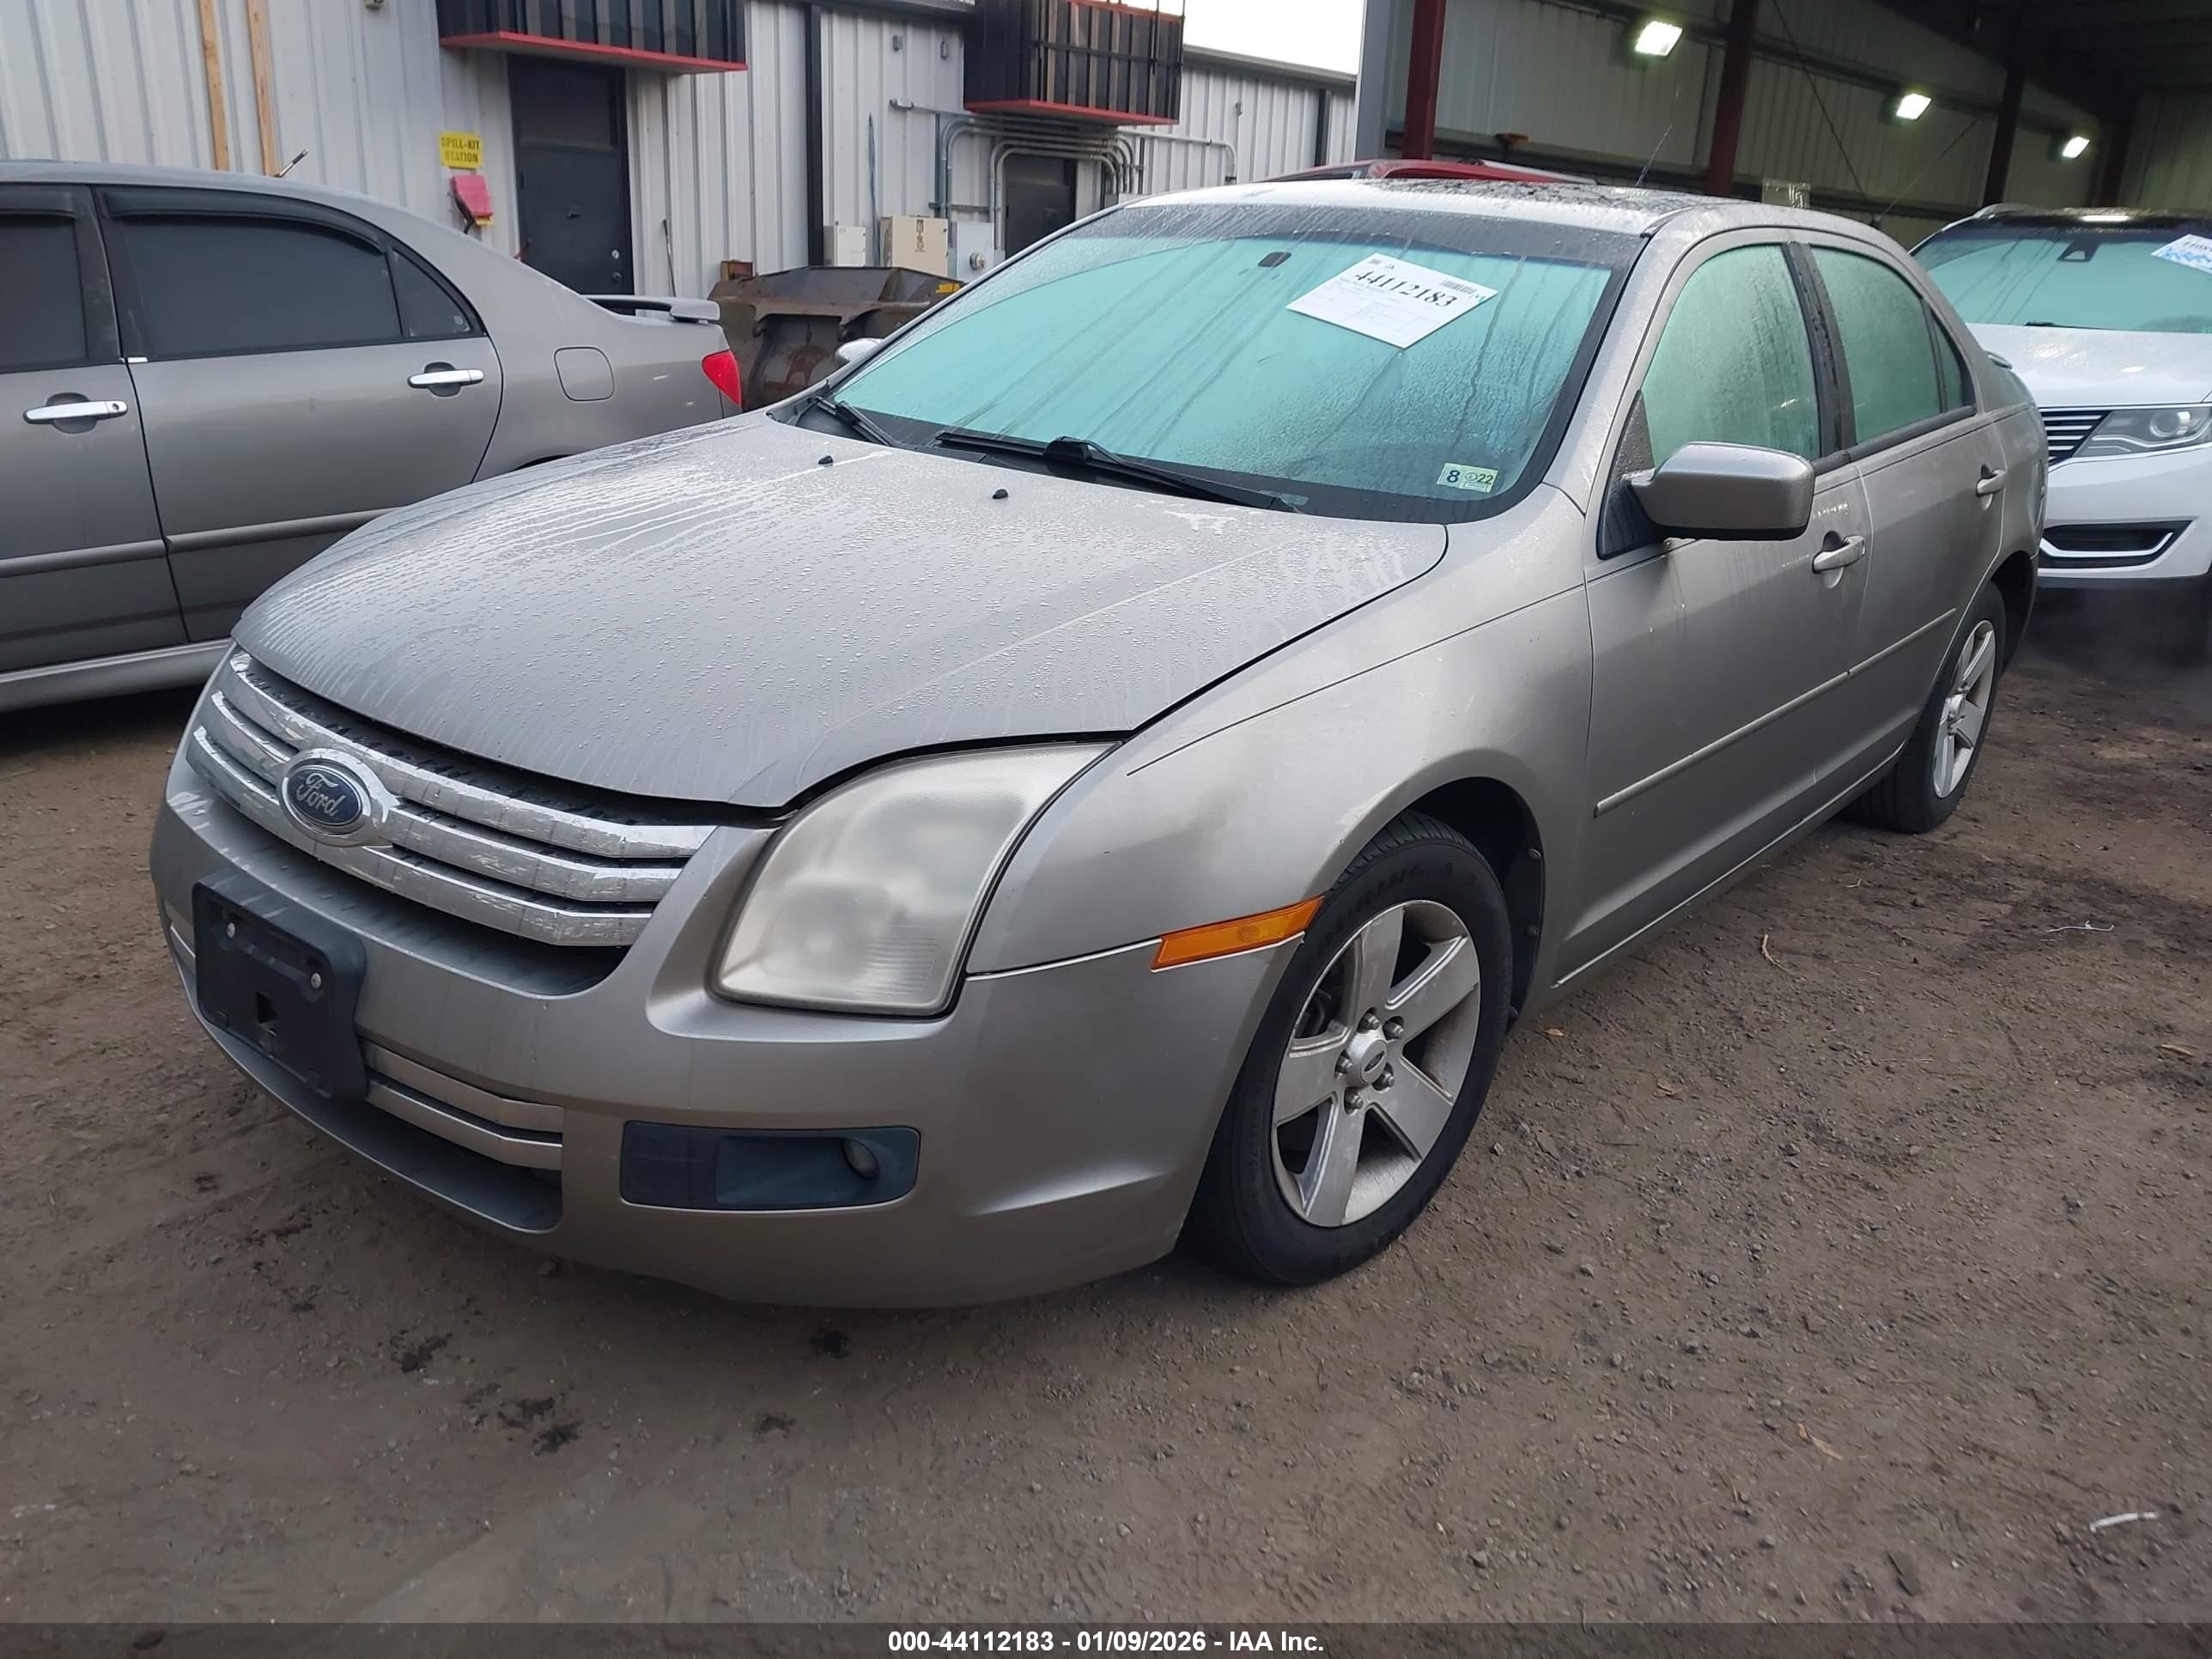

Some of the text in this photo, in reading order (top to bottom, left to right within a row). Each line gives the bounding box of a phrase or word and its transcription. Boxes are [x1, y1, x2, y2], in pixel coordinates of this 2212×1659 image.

[441, 137, 481, 150] SPILL-KIT
[445, 150, 479, 163] STATION
[1355, 270, 1457, 307] 44112183
[1446, 470, 1494, 485] 8 22
[296, 773, 346, 817] Ford
